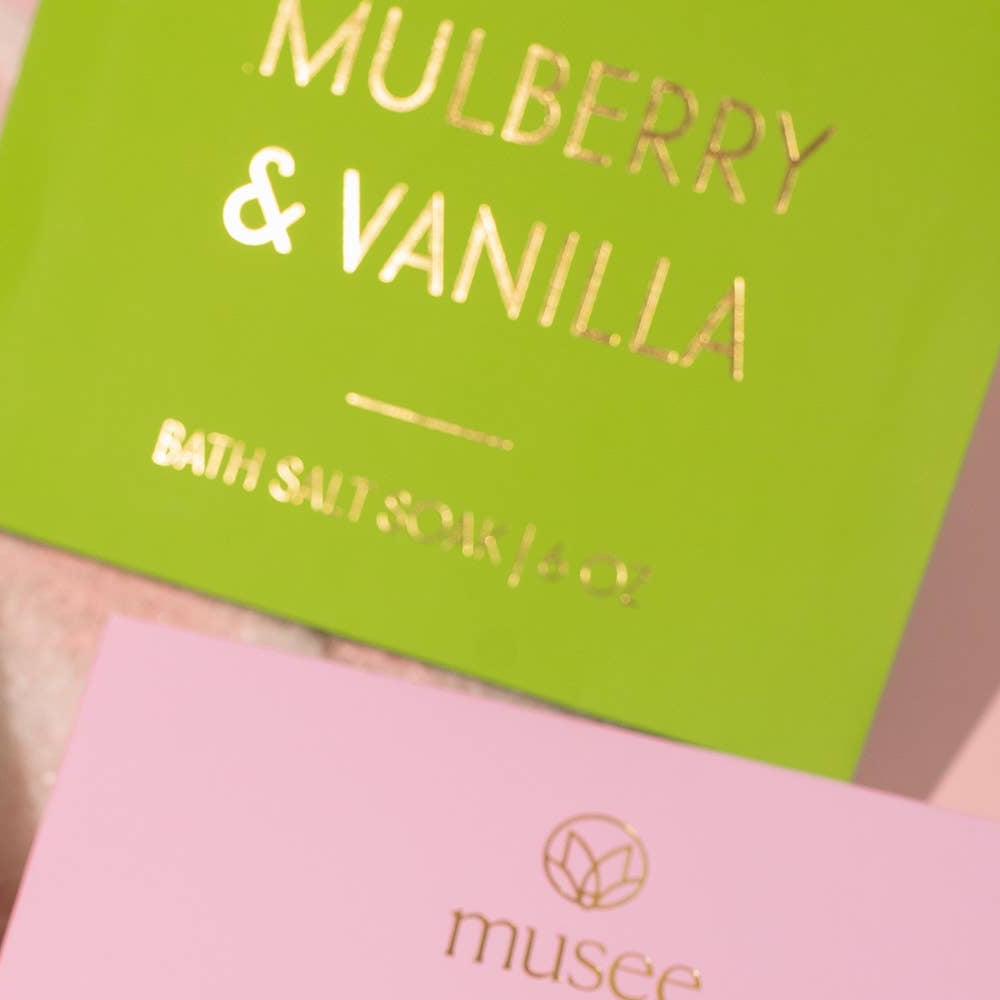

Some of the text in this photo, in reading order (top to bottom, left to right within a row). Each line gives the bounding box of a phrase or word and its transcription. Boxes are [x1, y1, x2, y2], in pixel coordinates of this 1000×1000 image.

[257, 0, 836, 213] MULBERRY
[222, 145, 745, 382] & VANILLA
[151, 418, 266, 491] BATH
[268, 456, 378, 523] SALT
[376, 490, 508, 566] SOAK
